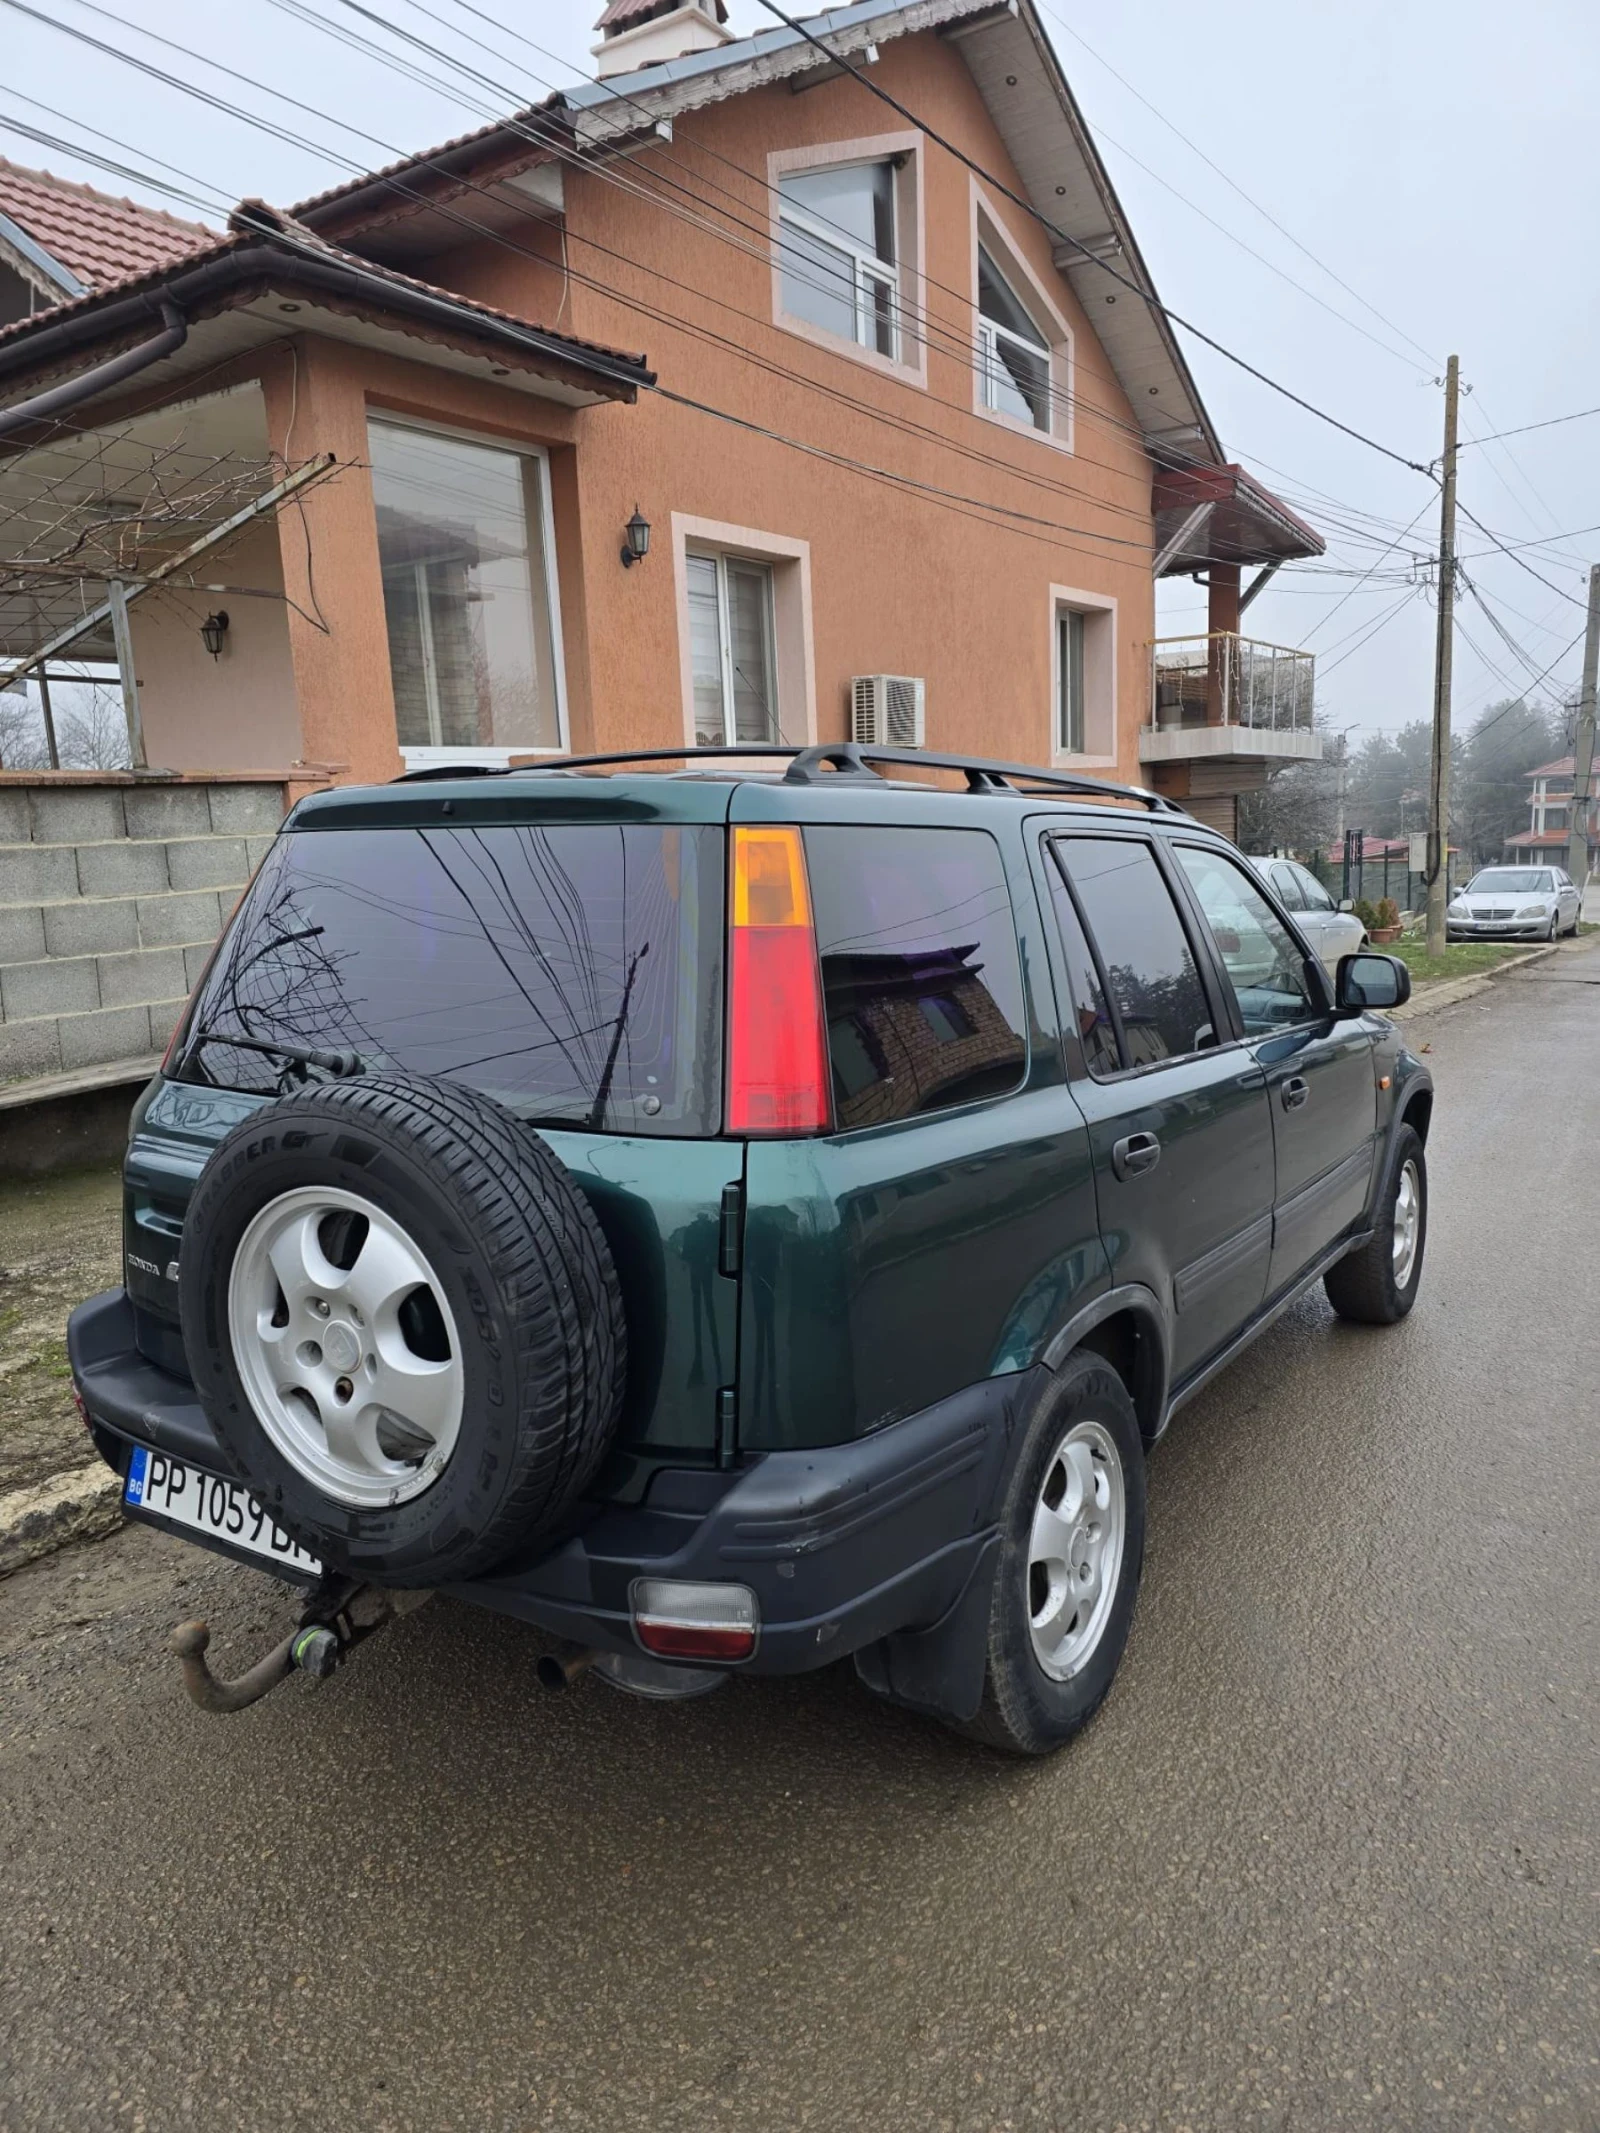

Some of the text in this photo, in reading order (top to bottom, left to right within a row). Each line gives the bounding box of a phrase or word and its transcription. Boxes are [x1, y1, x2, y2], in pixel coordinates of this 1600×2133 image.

[127, 1253, 160, 1276] HONDA
[128, 1480, 143, 1495] BG
[147, 1455, 186, 1509] PP
[196, 1472, 266, 1542] 1059
